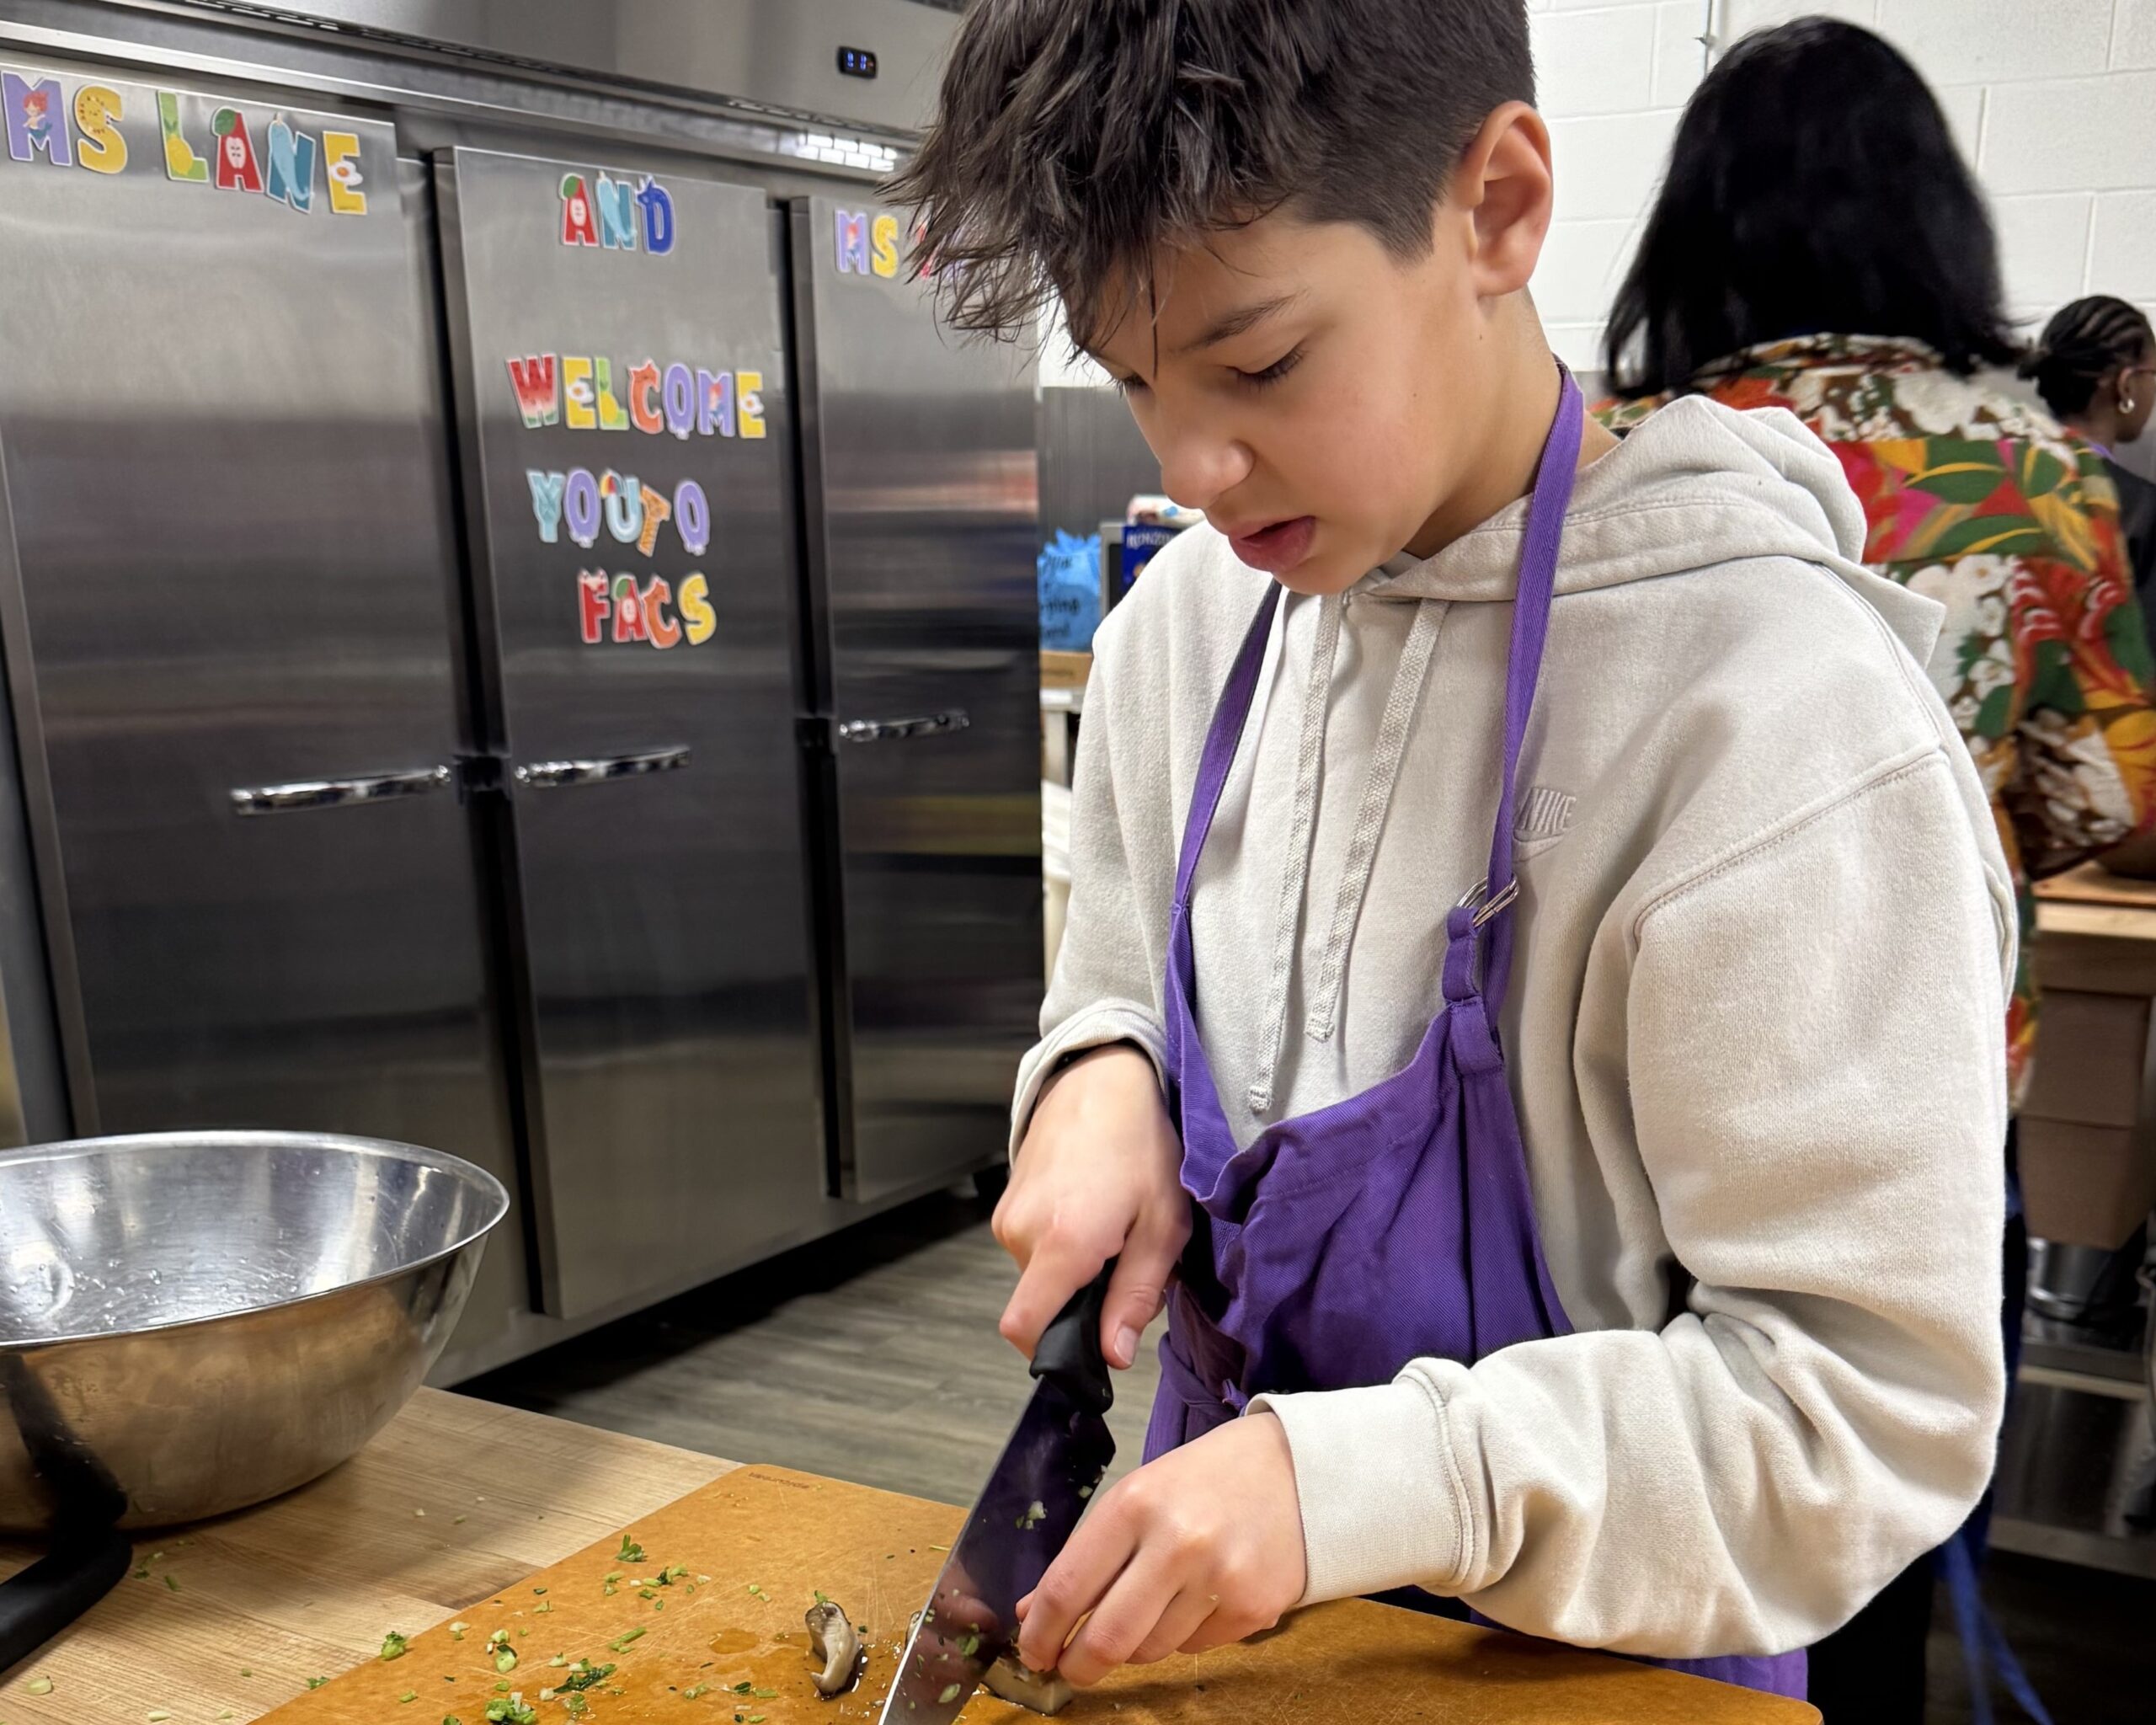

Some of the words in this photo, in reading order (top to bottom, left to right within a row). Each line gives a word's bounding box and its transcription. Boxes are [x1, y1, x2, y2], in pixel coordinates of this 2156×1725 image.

[2, 71, 127, 174] MS
[156, 90, 367, 215] LANE
[559, 170, 675, 256] AND
[835, 210, 898, 279] MS
[506, 352, 766, 440] WELCOME
[578, 568, 717, 649] FACS
[1518, 788, 1577, 834] NIKE
